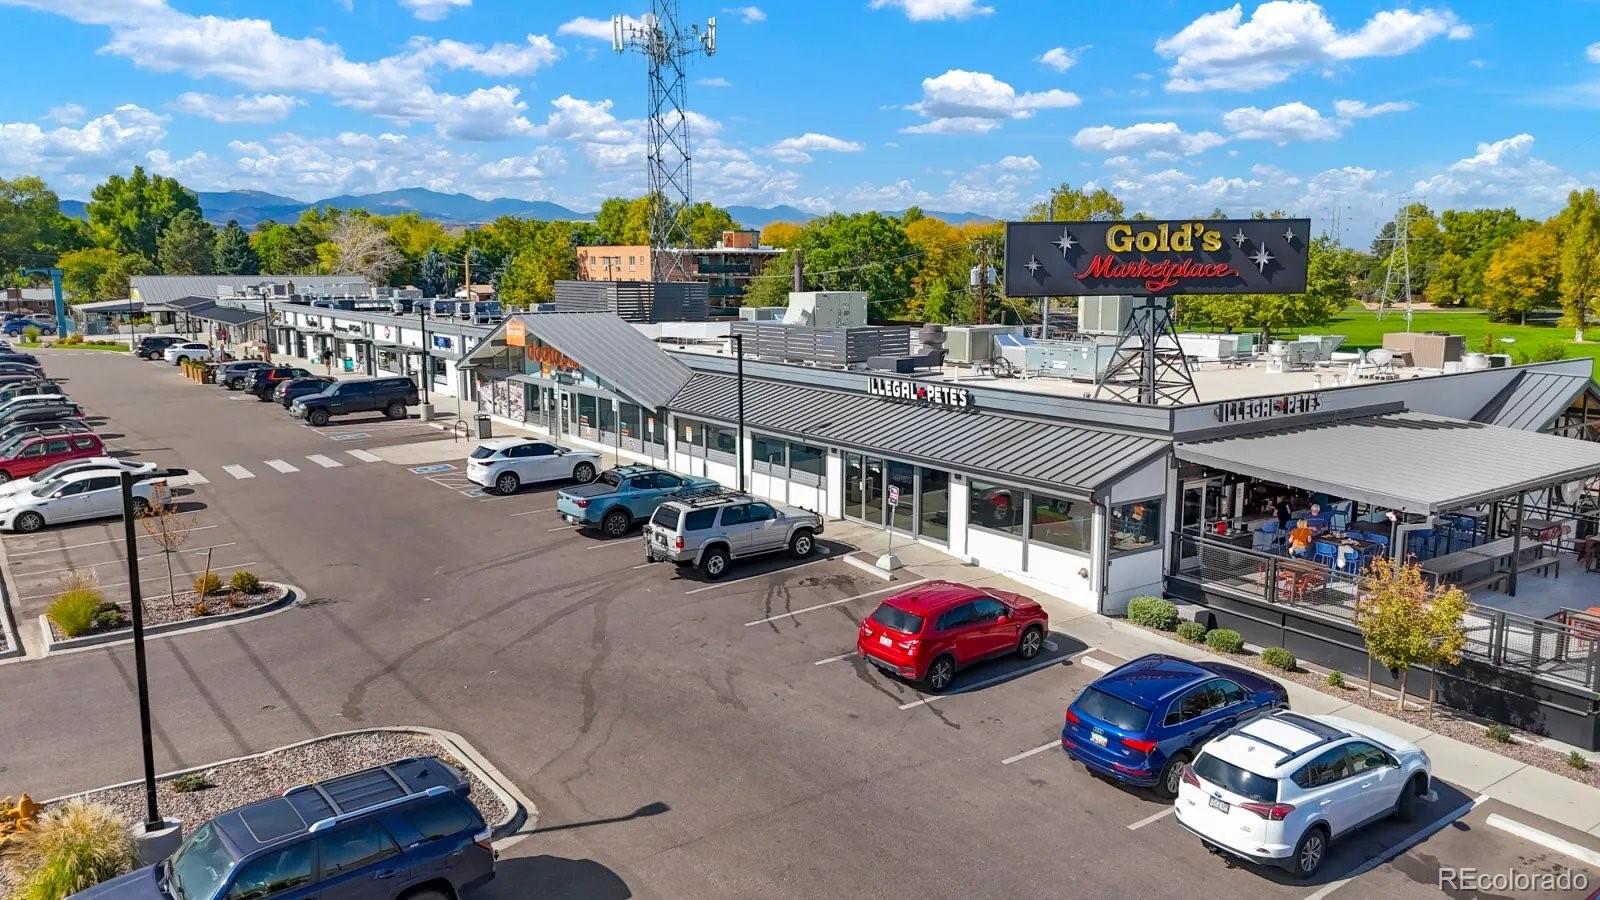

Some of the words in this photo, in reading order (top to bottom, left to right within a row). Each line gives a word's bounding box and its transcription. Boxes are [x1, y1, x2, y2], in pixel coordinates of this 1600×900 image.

[1105, 223, 1222, 252] Gold's
[1073, 254, 1240, 292] Marketplace
[867, 377, 918, 400] ILLEGAL
[926, 385, 967, 407] PETE'S
[1223, 397, 1278, 423] ILLEGAL
